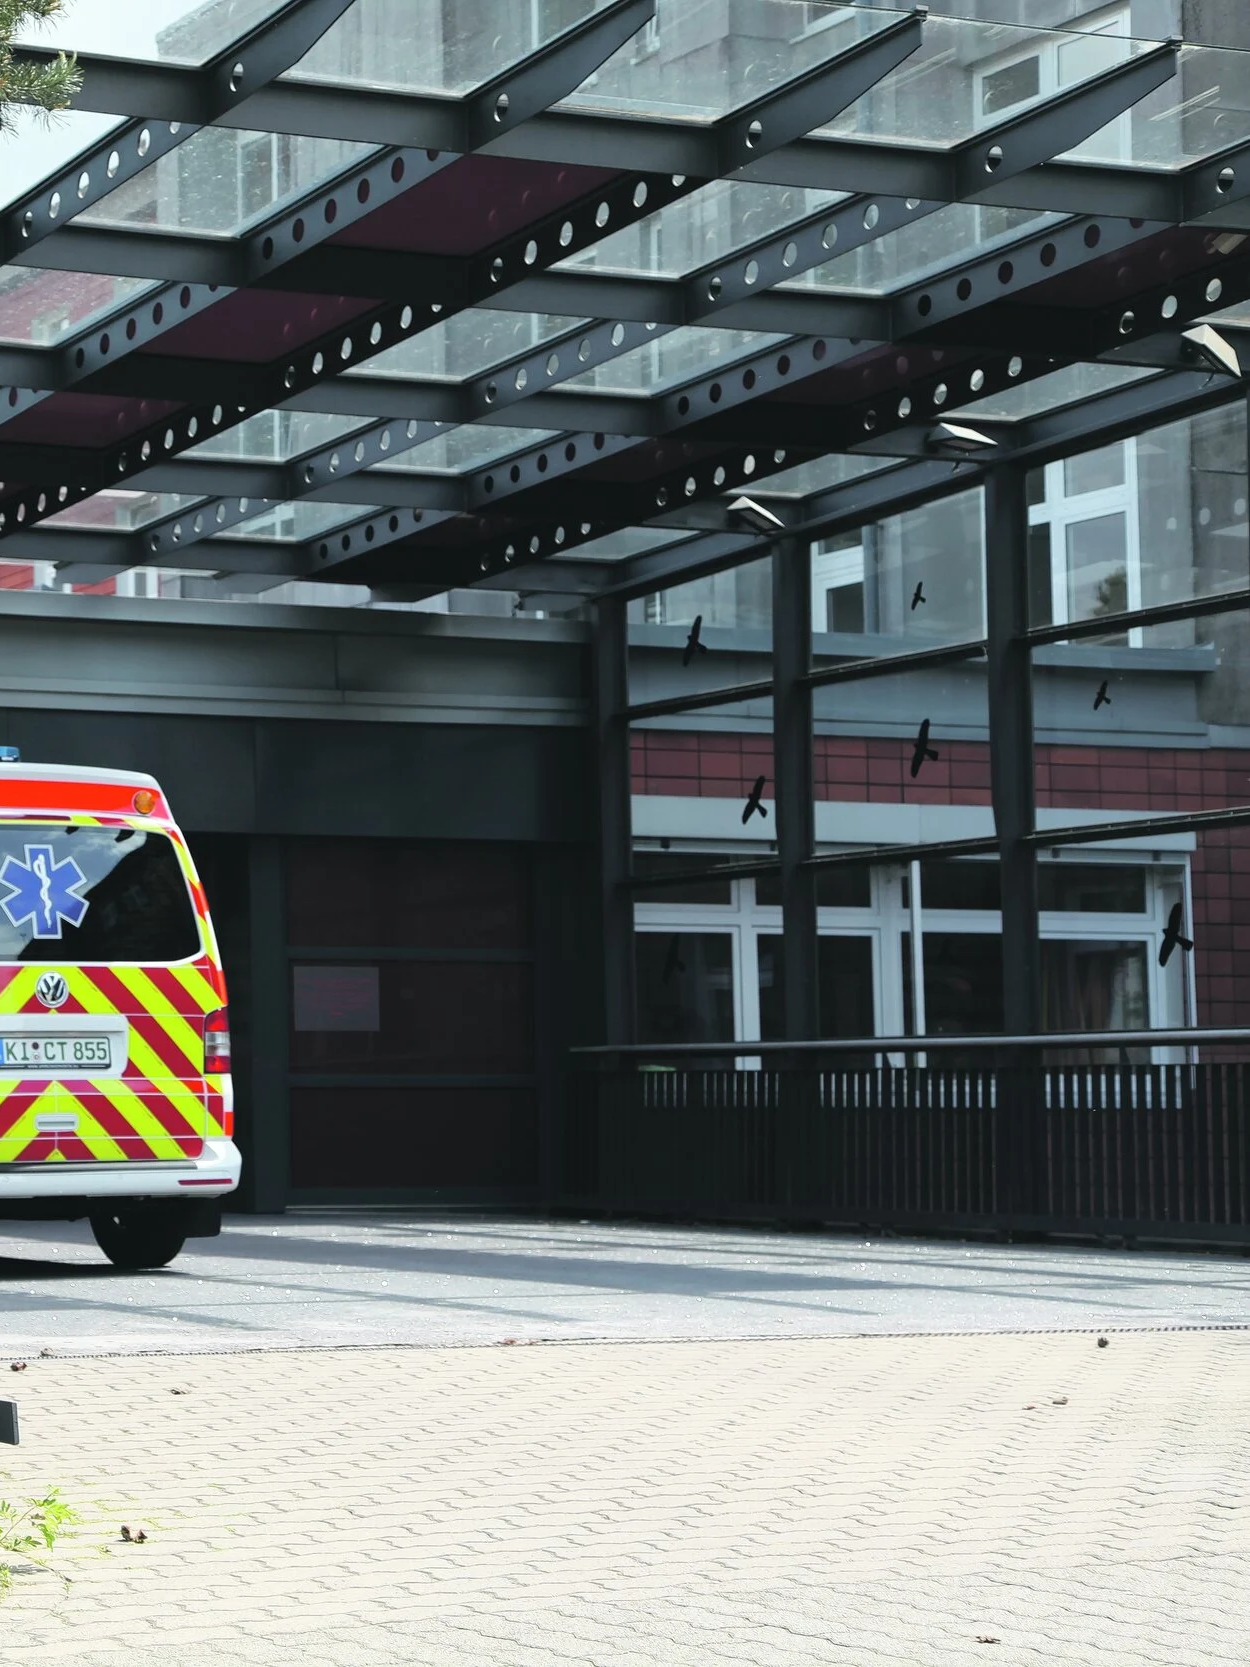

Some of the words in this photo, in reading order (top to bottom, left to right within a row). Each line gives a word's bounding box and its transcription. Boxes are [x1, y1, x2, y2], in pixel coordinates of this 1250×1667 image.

[5, 1042, 29, 1061] KI
[44, 1042, 68, 1060] CT
[73, 1042, 107, 1060] 855
